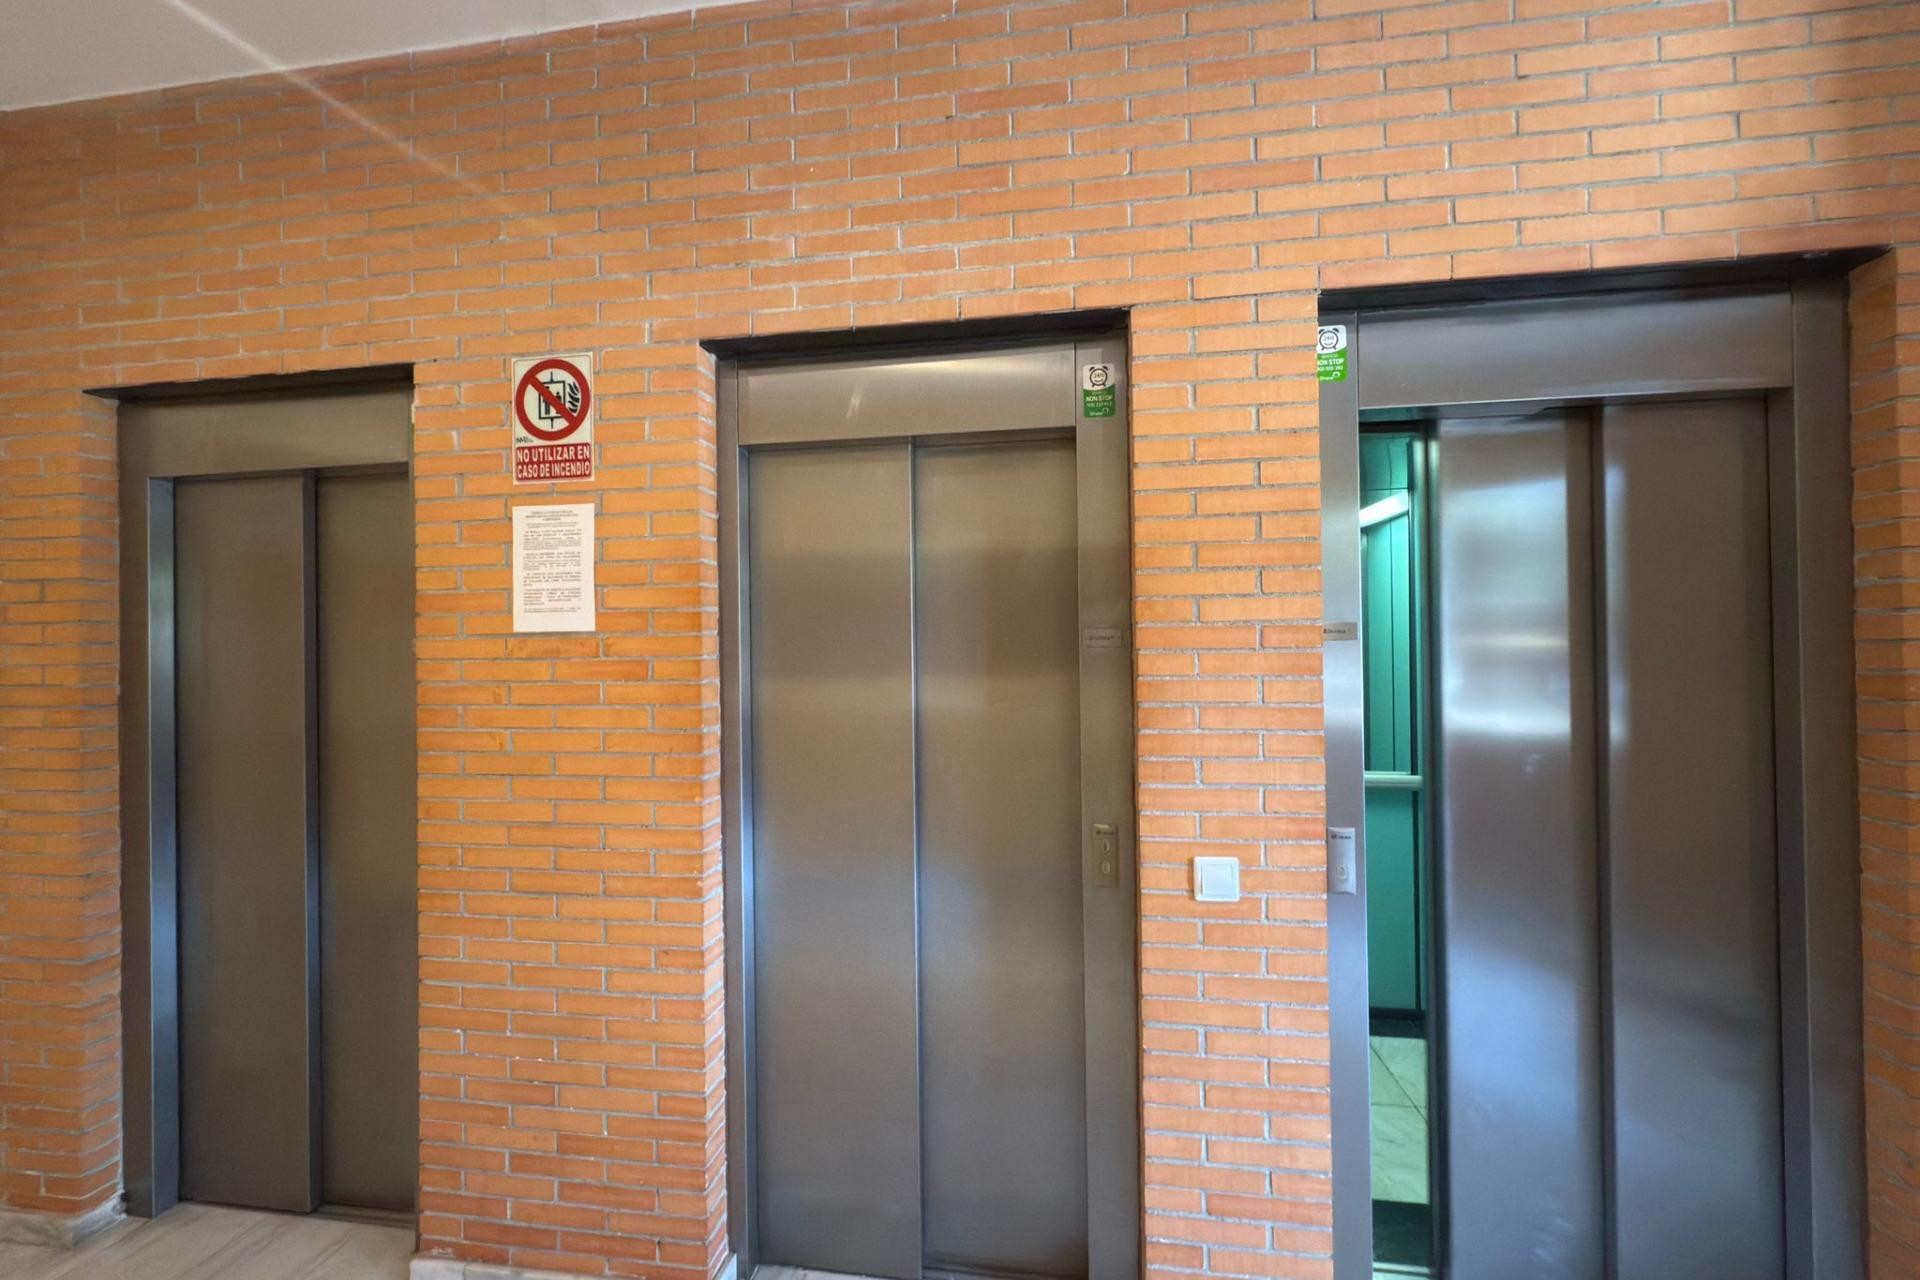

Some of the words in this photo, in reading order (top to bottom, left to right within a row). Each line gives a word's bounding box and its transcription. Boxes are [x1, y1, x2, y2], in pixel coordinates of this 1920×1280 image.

[517, 448, 530, 463] NO
[531, 446, 576, 462] UTILIZAR
[577, 445, 590, 460] EN
[517, 464, 539, 479] CASO
[539, 463, 551, 478] DE
[551, 461, 591, 477] INCENDIO
